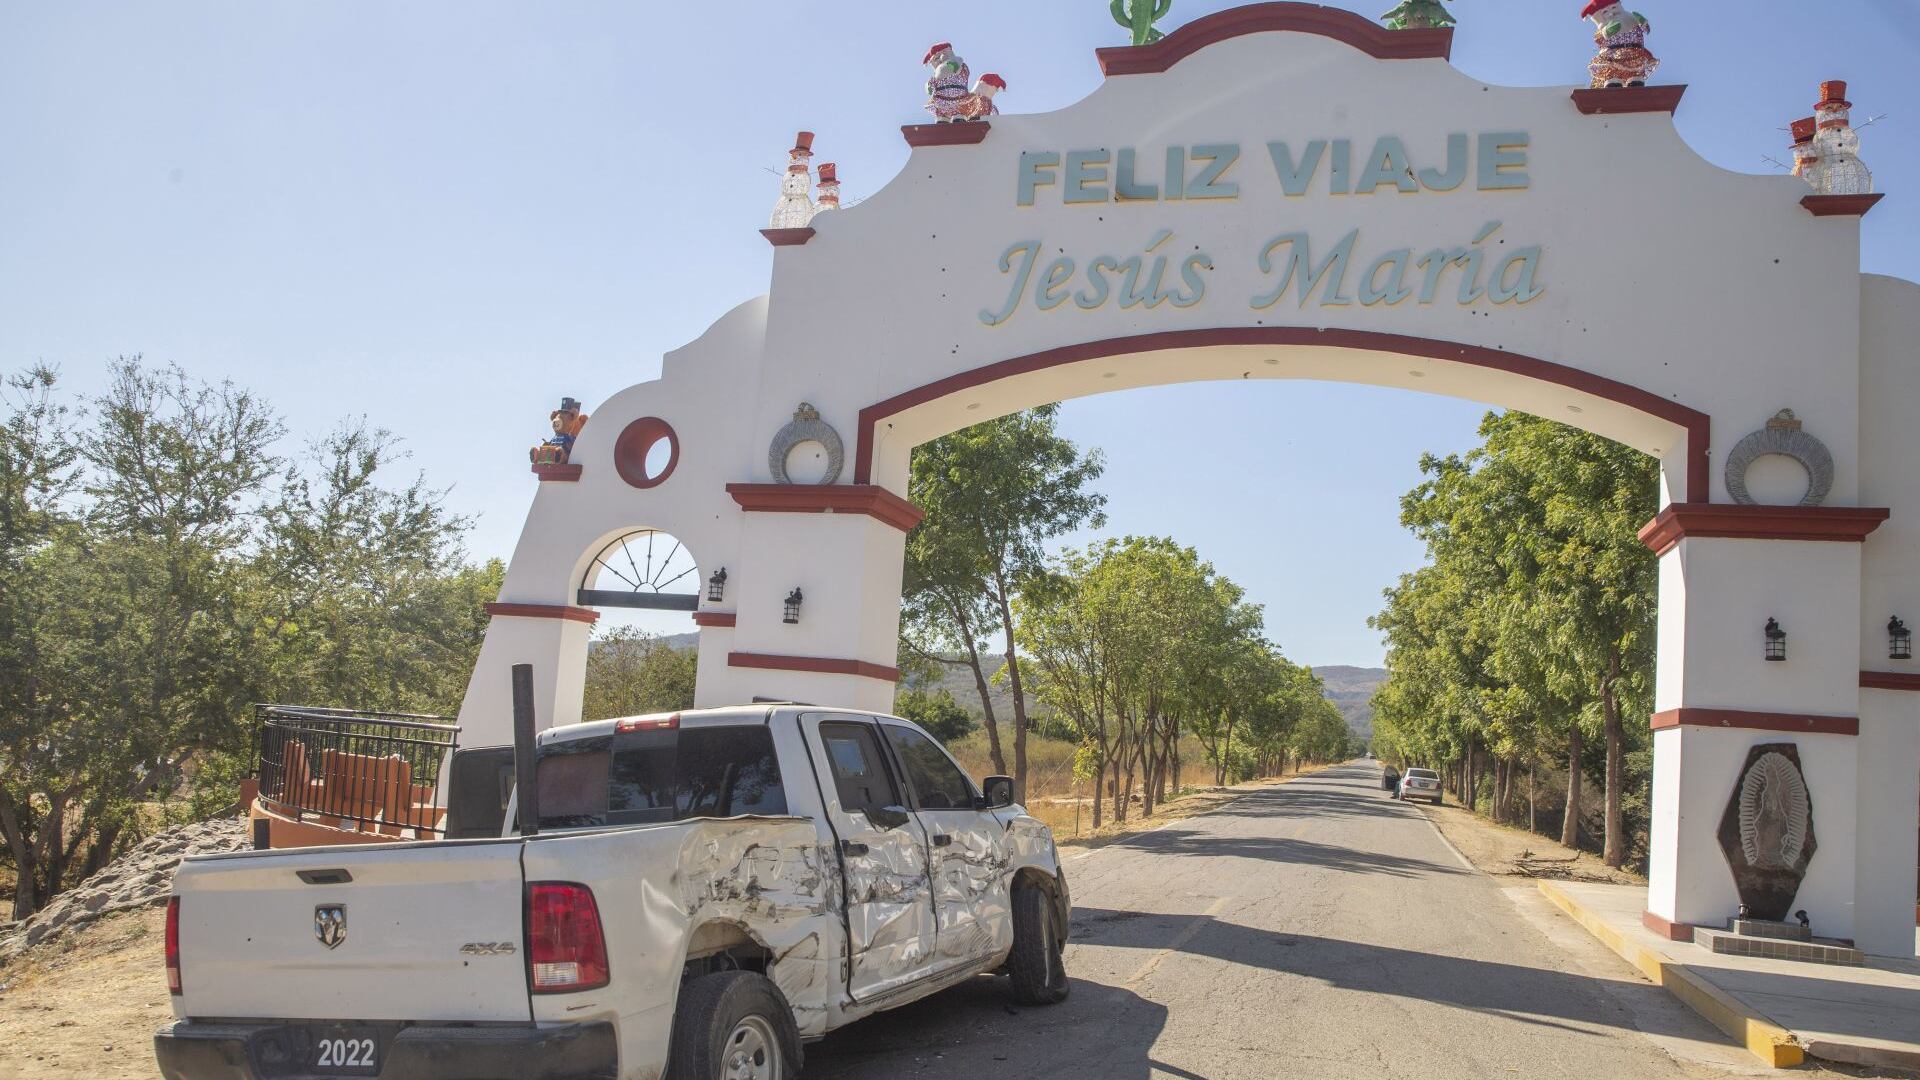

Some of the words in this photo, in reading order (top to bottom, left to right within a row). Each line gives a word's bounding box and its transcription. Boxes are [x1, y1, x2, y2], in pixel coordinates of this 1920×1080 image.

[1017, 143, 1240, 206] FELIZ
[1266, 132, 1529, 196] VIAJE
[979, 229, 1213, 325] Jesús
[1250, 219, 1545, 309] María
[317, 1039, 375, 1066] 2022
